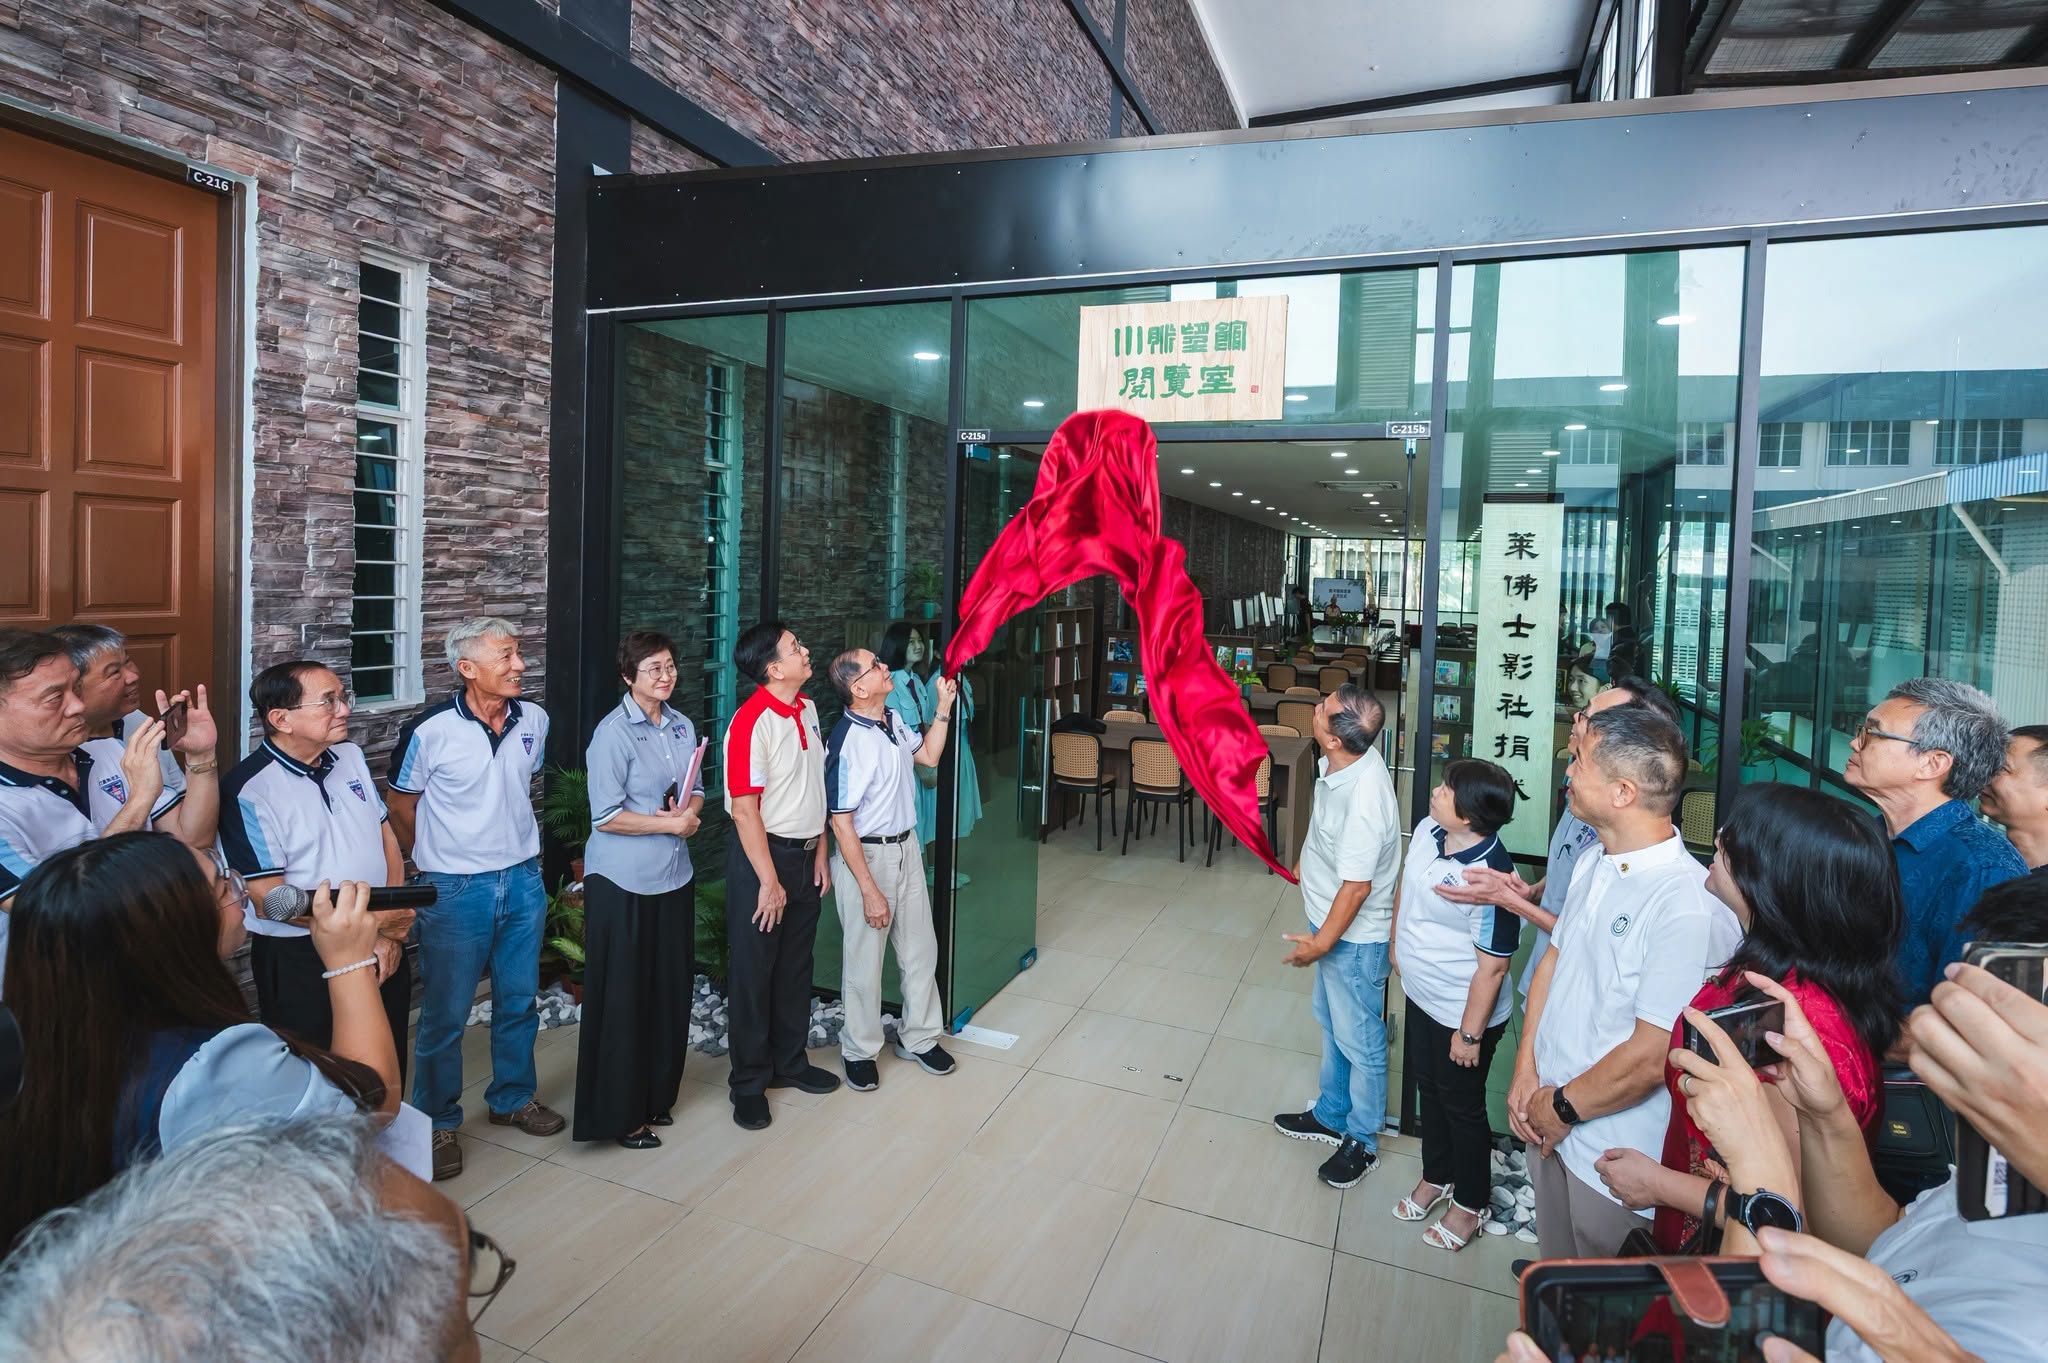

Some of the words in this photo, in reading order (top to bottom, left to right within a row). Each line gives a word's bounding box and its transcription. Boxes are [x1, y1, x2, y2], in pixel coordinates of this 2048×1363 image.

[194, 172, 229, 191] C-216
[1118, 362, 1237, 401] 閱覽室
[961, 432, 986, 440] C-215a
[1391, 424, 1426, 434] C-215b
